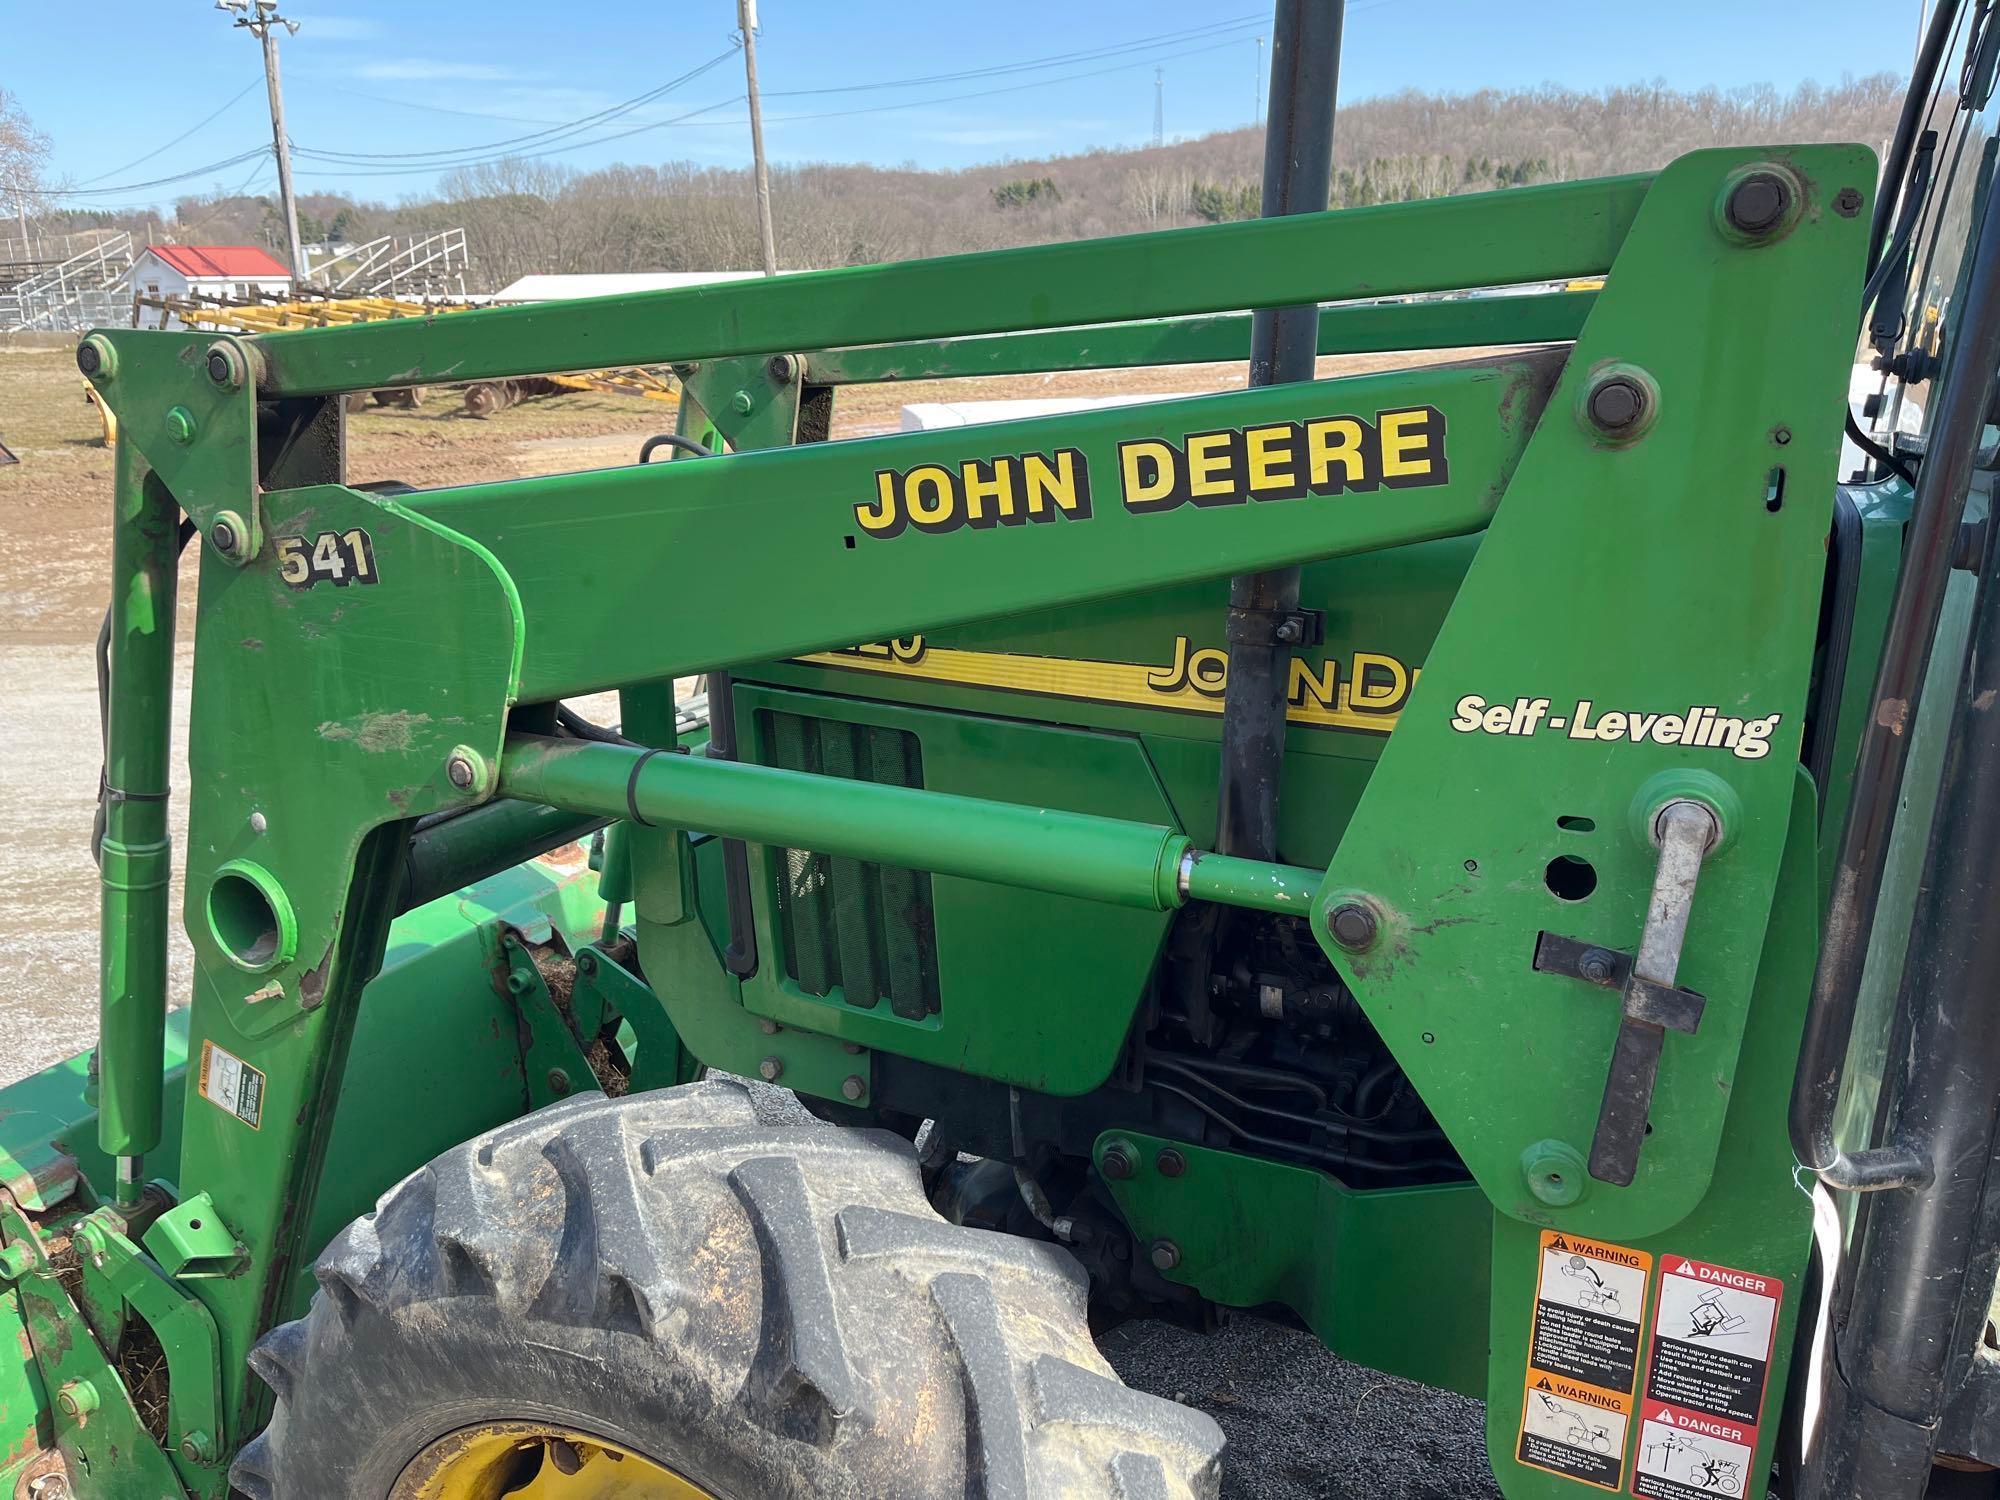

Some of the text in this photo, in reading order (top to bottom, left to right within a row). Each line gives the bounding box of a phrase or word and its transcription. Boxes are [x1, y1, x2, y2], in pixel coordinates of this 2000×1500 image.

[854, 405, 1448, 538] JOHN DEERE
[274, 529, 378, 590] 541
[1148, 636, 1342, 710] JON
[1573, 1242, 1639, 1266] WARNING
[1699, 1267, 1766, 1292] DANGER
[1547, 1312, 1566, 1322] falling
[1565, 1311, 1583, 1320] injury
[1593, 1319, 1610, 1327] death
[1612, 1324, 1634, 1333] caused
[1539, 1331, 1568, 1340] approved
[1584, 1342, 1611, 1354] handling
[1562, 1324, 1583, 1334] handle
[1584, 1330, 1603, 1339] round
[1605, 1335, 1621, 1344] bales
[1562, 1330, 1581, 1339] loader
[1590, 1338, 1618, 1349] equipped
[1538, 1341, 1563, 1351] Lockout
[1564, 1348, 1589, 1358] optional
[1591, 1354, 1607, 1363] valve
[1538, 1347, 1559, 1356] Handle
[1560, 1353, 1579, 1361] raised
[1581, 1358, 1597, 1366] loads
[1661, 1349, 1730, 1370] result from rollovers.
[1662, 1341, 1687, 1353] Serious
[1689, 1348, 1709, 1359] injury
[1719, 1357, 1738, 1365] death
[1537, 1357, 1552, 1366] Carry
[1554, 1362, 1571, 1370] loads
[1659, 1362, 1679, 1371] times.
[1660, 1355, 1673, 1363] Use
[1706, 1368, 1733, 1378] seatbelt
[1657, 1376, 1675, 1385] Move
[1677, 1381, 1700, 1391] wheels
[1710, 1391, 1732, 1400] widest
[1673, 1374, 1701, 1385] required
[1557, 1383, 1621, 1410] WARNING
[1657, 1384, 1704, 1399] recommended
[1655, 1390, 1681, 1401] Operate
[1683, 1397, 1705, 1407] tractor
[1728, 1409, 1754, 1419] speeds.
[1678, 1415, 1742, 1440] DANGER
[1536, 1440, 1552, 1448] avoid
[1553, 1445, 1571, 1454] injury
[1640, 1476, 1665, 1486] Serious
[1666, 1482, 1685, 1492] injury
[1640, 1482, 1658, 1490] result
[1659, 1487, 1674, 1496] from
